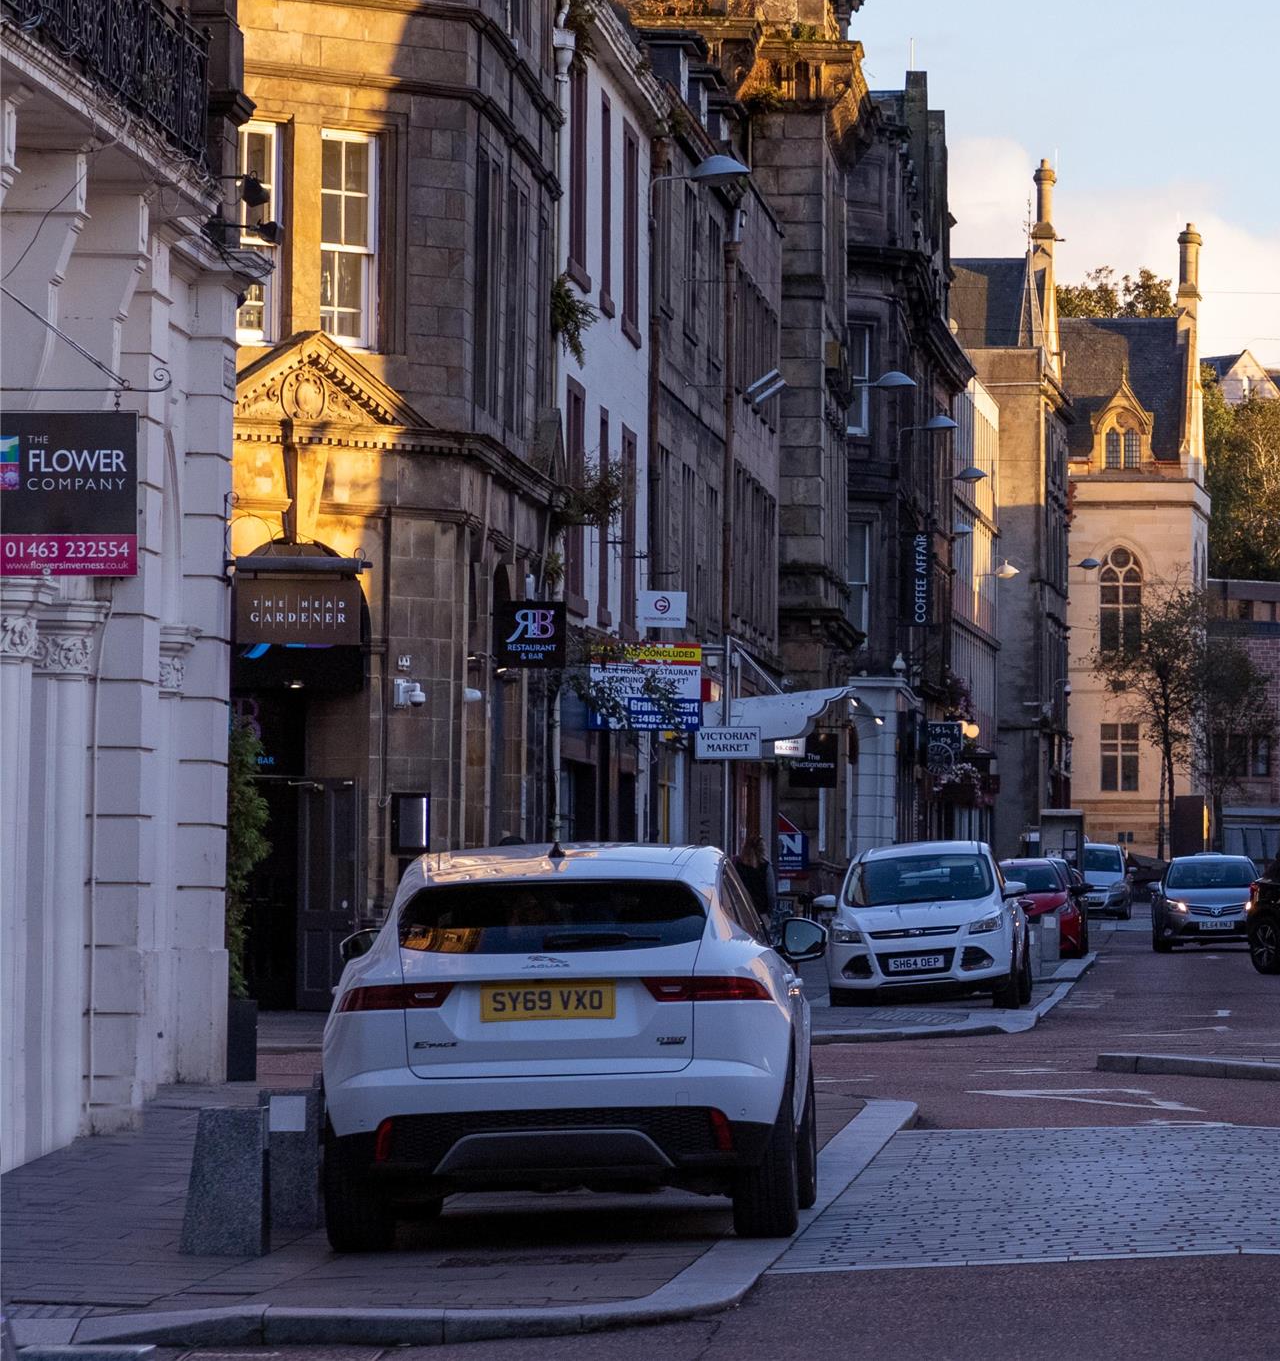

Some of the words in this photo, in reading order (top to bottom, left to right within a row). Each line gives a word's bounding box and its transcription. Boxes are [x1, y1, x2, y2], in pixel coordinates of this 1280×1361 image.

[27, 435, 49, 445] THE
[28, 449, 127, 473] FLOWER
[27, 478, 126, 491] COMPANY
[5, 541, 59, 558] 01463
[65, 541, 130, 558] 232554
[6, 560, 129, 570] www.flowersinverness.co.uk
[253, 600, 284, 608] THE
[301, 600, 345, 608] HEAD
[914, 578, 927, 623] COFFEE
[250, 612, 347, 623] GARDENER
[507, 644, 557, 652] RESTAURANT
[643, 649, 696, 658] CONCLUDED
[700, 732, 757, 741] VICTORIAN
[706, 743, 750, 752] MARKET
[807, 752, 821, 760] The
[892, 959, 918, 970] SH64
[492, 990, 552, 1013] SY69
[559, 989, 603, 1011] VXO
